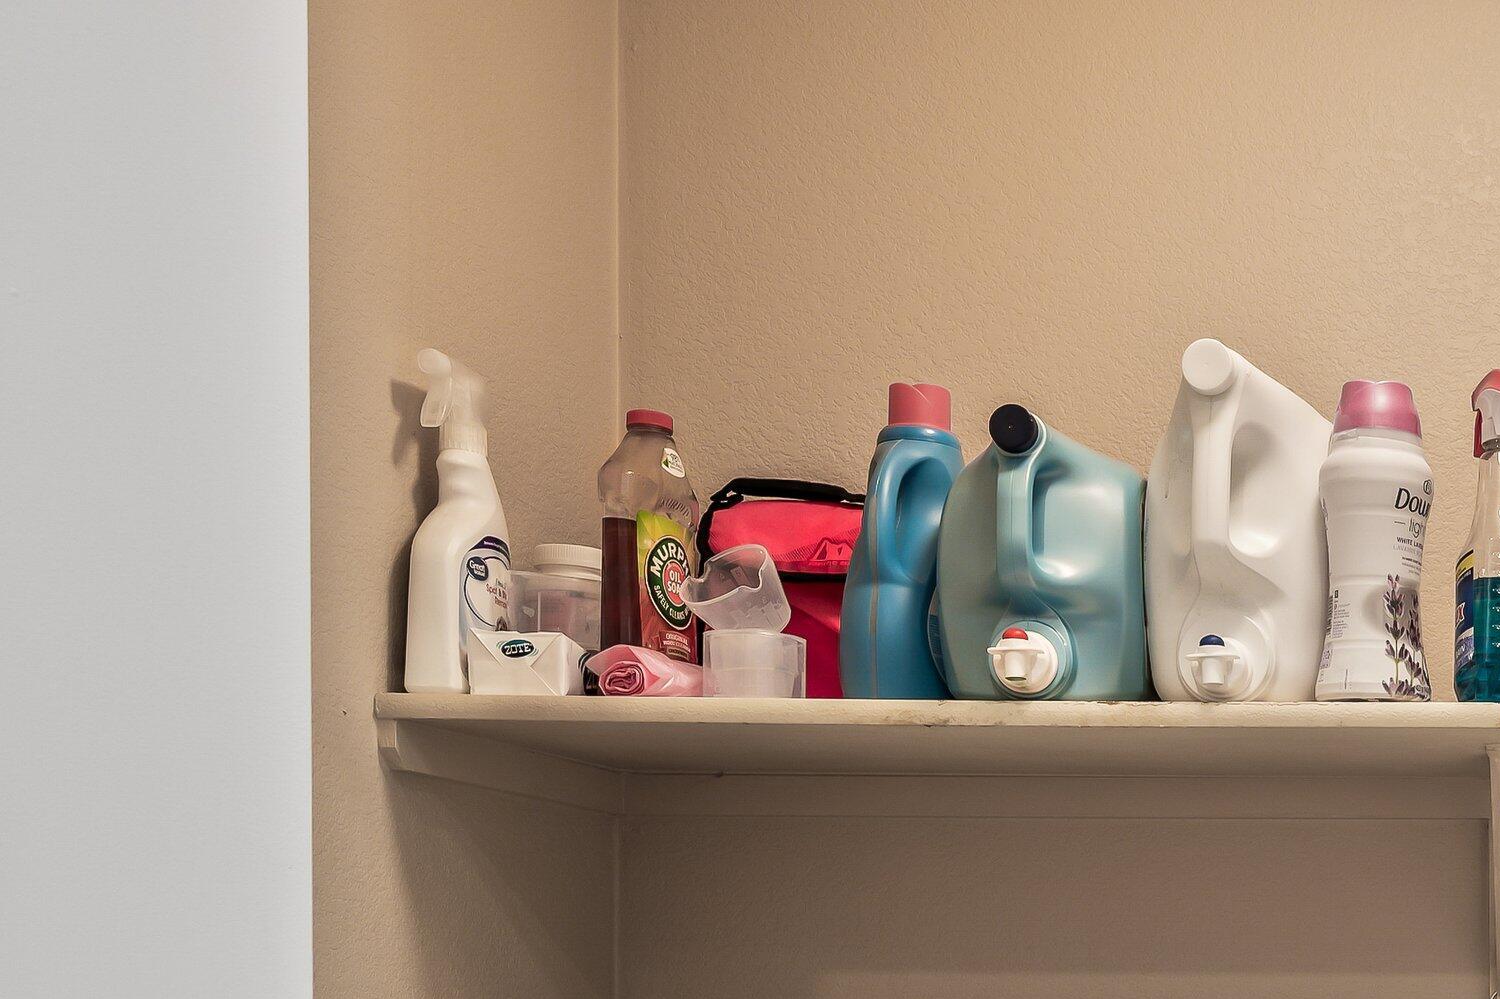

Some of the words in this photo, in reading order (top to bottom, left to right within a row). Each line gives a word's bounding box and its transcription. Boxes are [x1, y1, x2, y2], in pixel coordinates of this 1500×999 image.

[1394, 487, 1431, 518] Dow
[650, 543, 689, 578] MURPH
[669, 571, 682, 583] OIL
[667, 582, 682, 596] SOA
[503, 643, 533, 656] ZOTE
